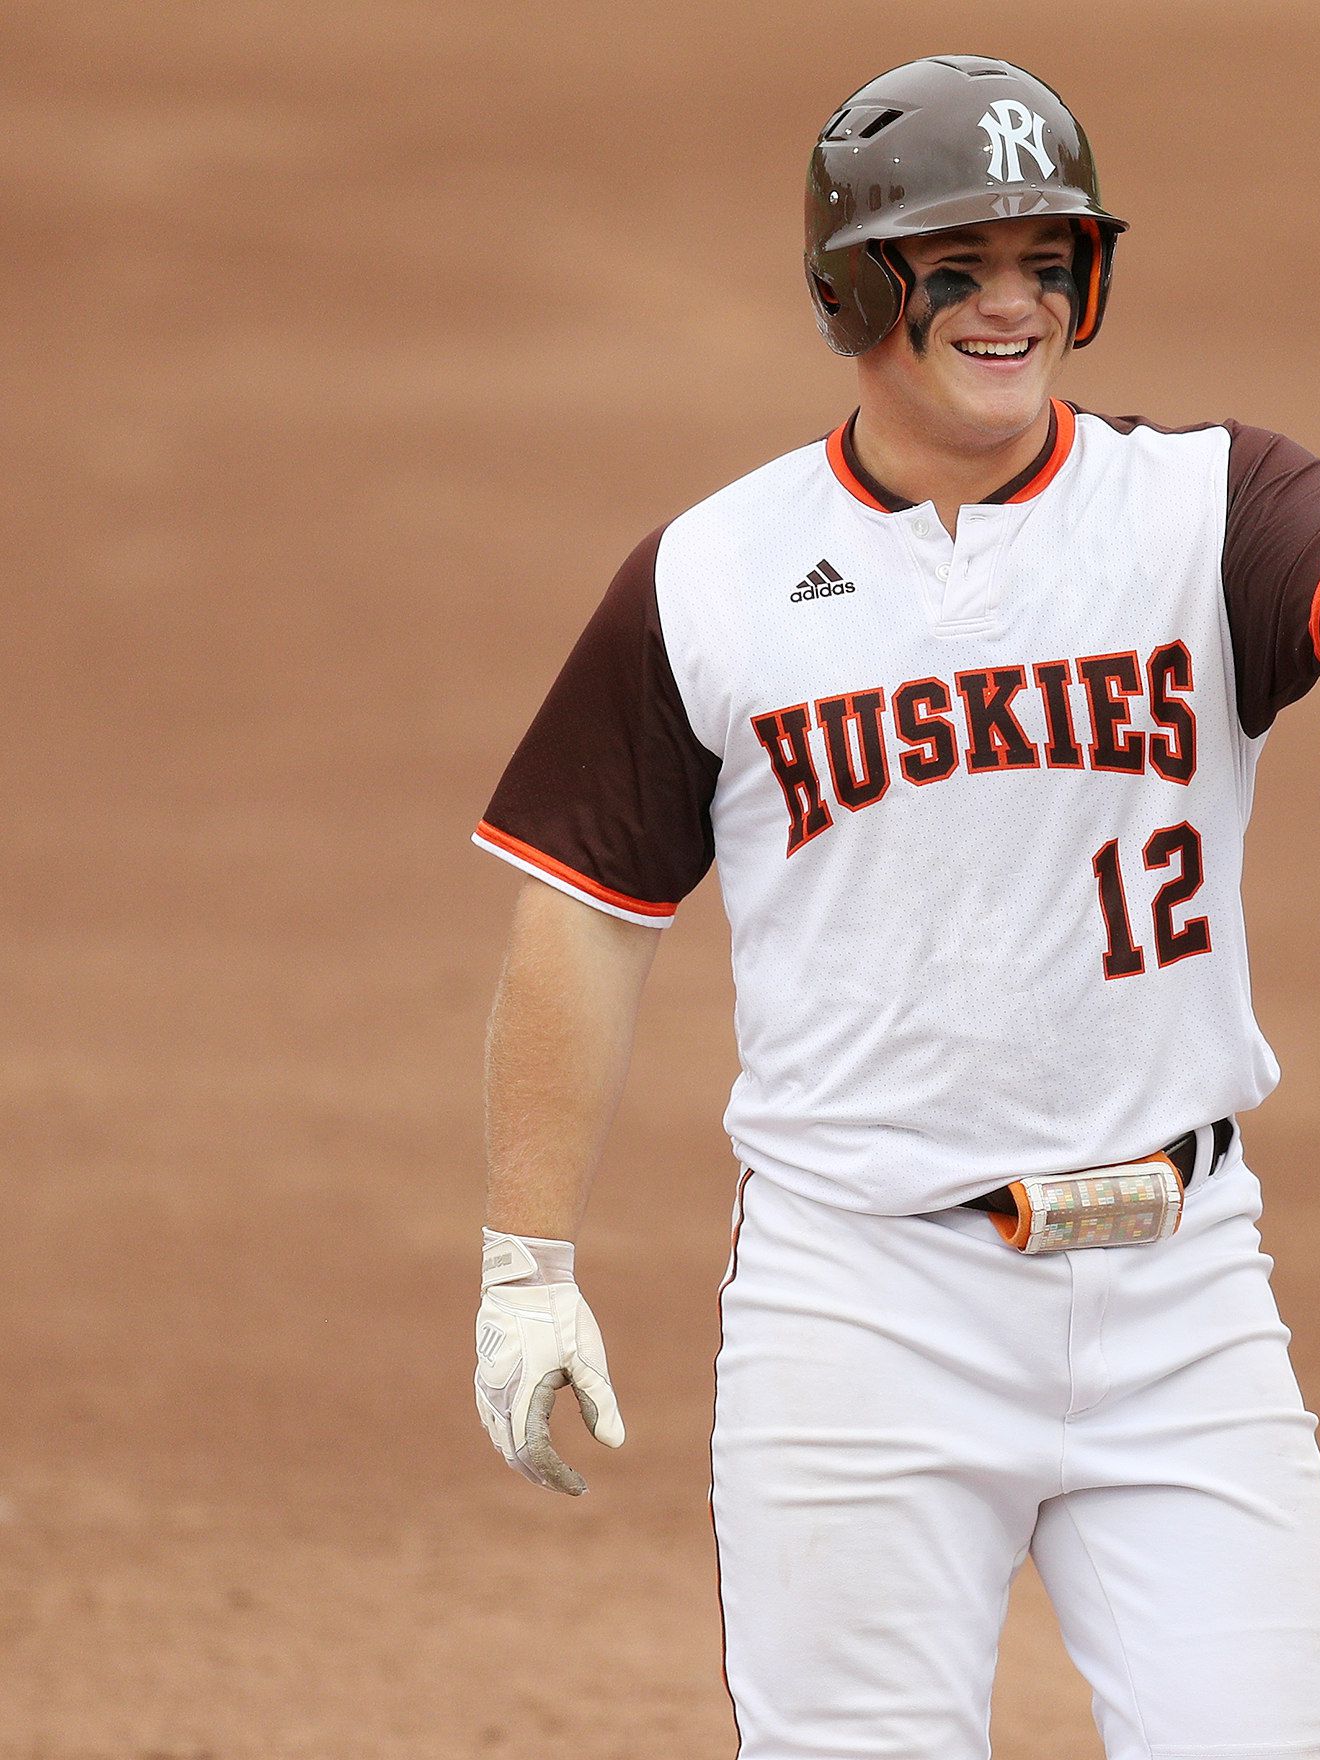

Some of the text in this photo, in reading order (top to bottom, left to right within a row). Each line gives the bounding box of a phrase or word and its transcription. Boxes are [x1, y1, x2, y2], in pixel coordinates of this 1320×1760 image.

[790, 582, 856, 603] adidas
[750, 638, 1197, 859] HUSKIES
[1092, 820, 1212, 981] 12
